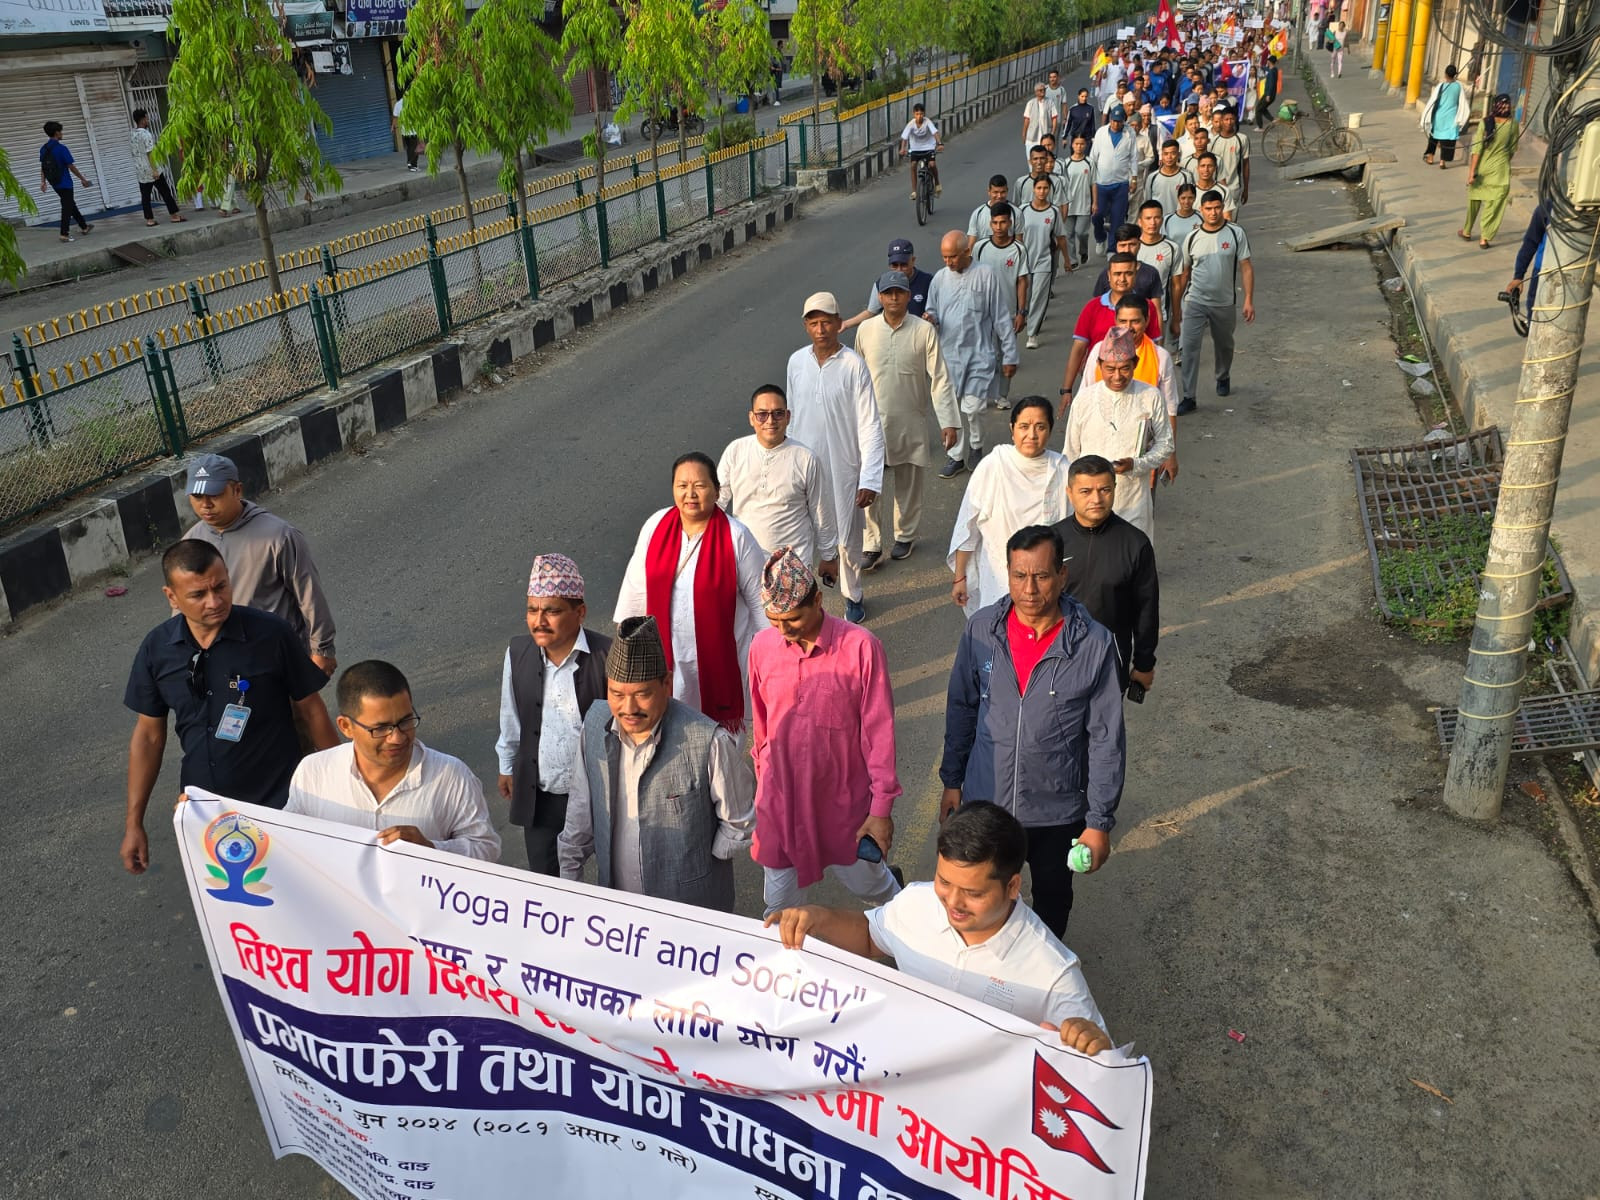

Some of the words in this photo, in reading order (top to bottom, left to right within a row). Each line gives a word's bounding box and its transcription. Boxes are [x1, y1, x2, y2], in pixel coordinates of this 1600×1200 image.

[229, 921, 313, 994] विश्व
[326, 930, 414, 997] योग
[524, 901, 575, 940] For
[584, 915, 650, 958] Self
[657, 937, 721, 977] and
[653, 999, 724, 1043] लागि
[737, 1021, 800, 1060] योग
[248, 1002, 463, 1094] प्रभातफेरी
[479, 1044, 576, 1098] तथा
[590, 1063, 686, 1129] योग
[699, 1097, 846, 1200] साधना
[353, 1109, 388, 1130] जुन
[397, 1117, 458, 1132] २०२४
[564, 1122, 622, 1151] असार
[631, 1138, 647, 1152] ७
